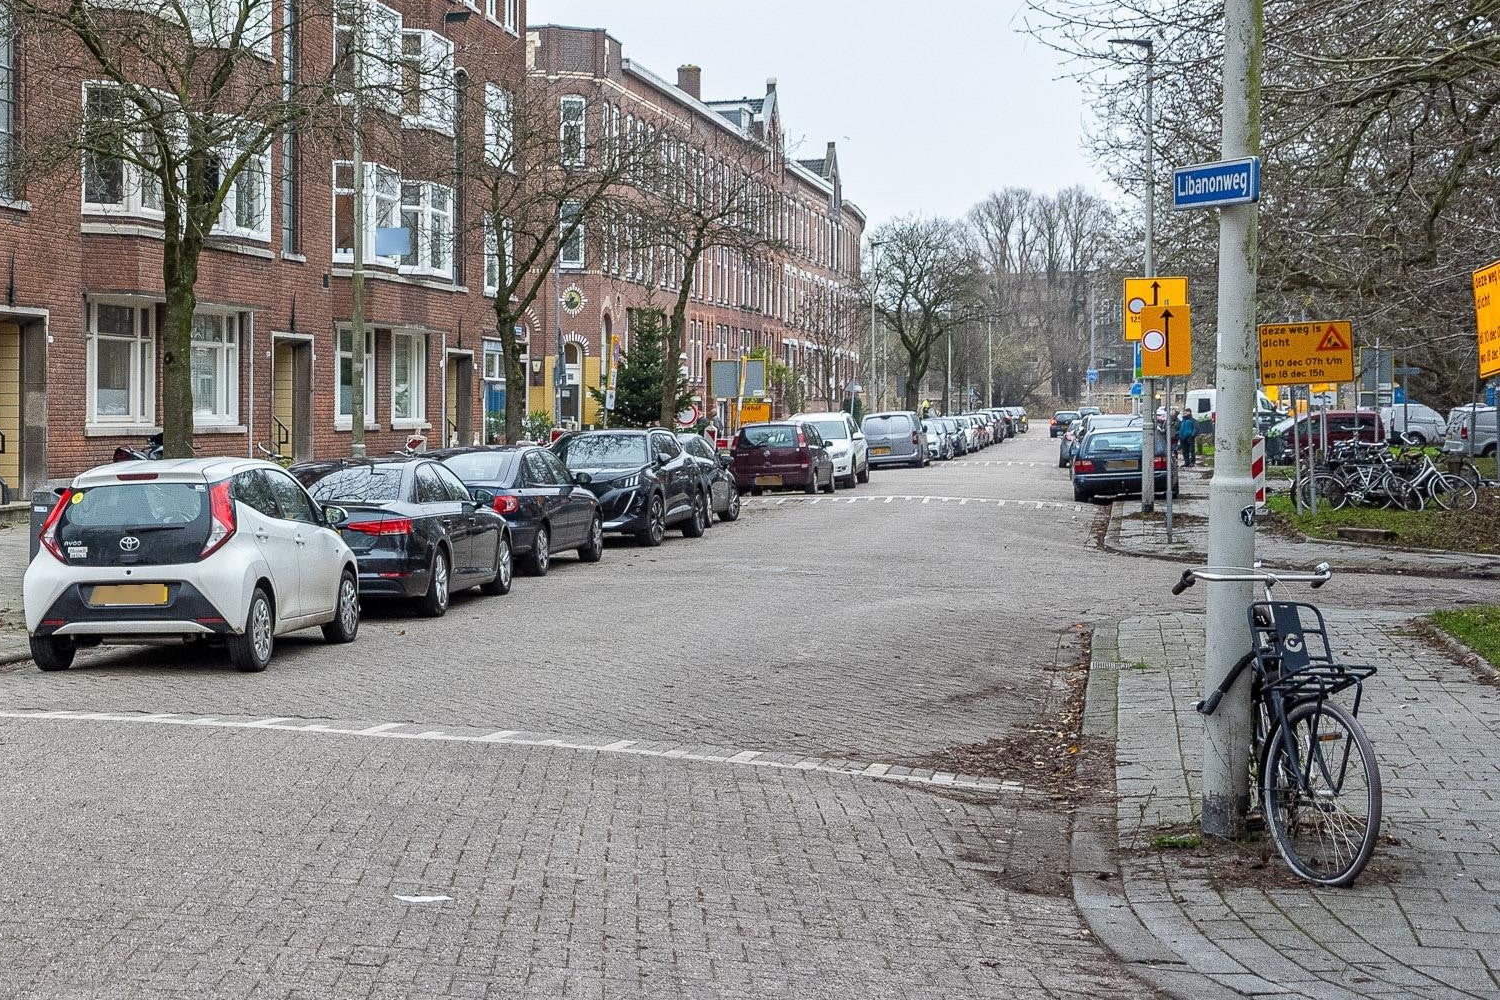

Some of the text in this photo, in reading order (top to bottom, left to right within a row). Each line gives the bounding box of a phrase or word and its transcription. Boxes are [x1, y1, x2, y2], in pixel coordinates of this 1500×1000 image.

[1177, 172, 1248, 197] Libanonweg
[1262, 325, 1322, 335] deze weg is
[1262, 338, 1291, 347] dicht
[1263, 357, 1343, 368] di 10 dec 07h t/m
[1279, 370, 1288, 378] 18
[1291, 369, 1307, 378] dec
[1310, 368, 1325, 377] 15h
